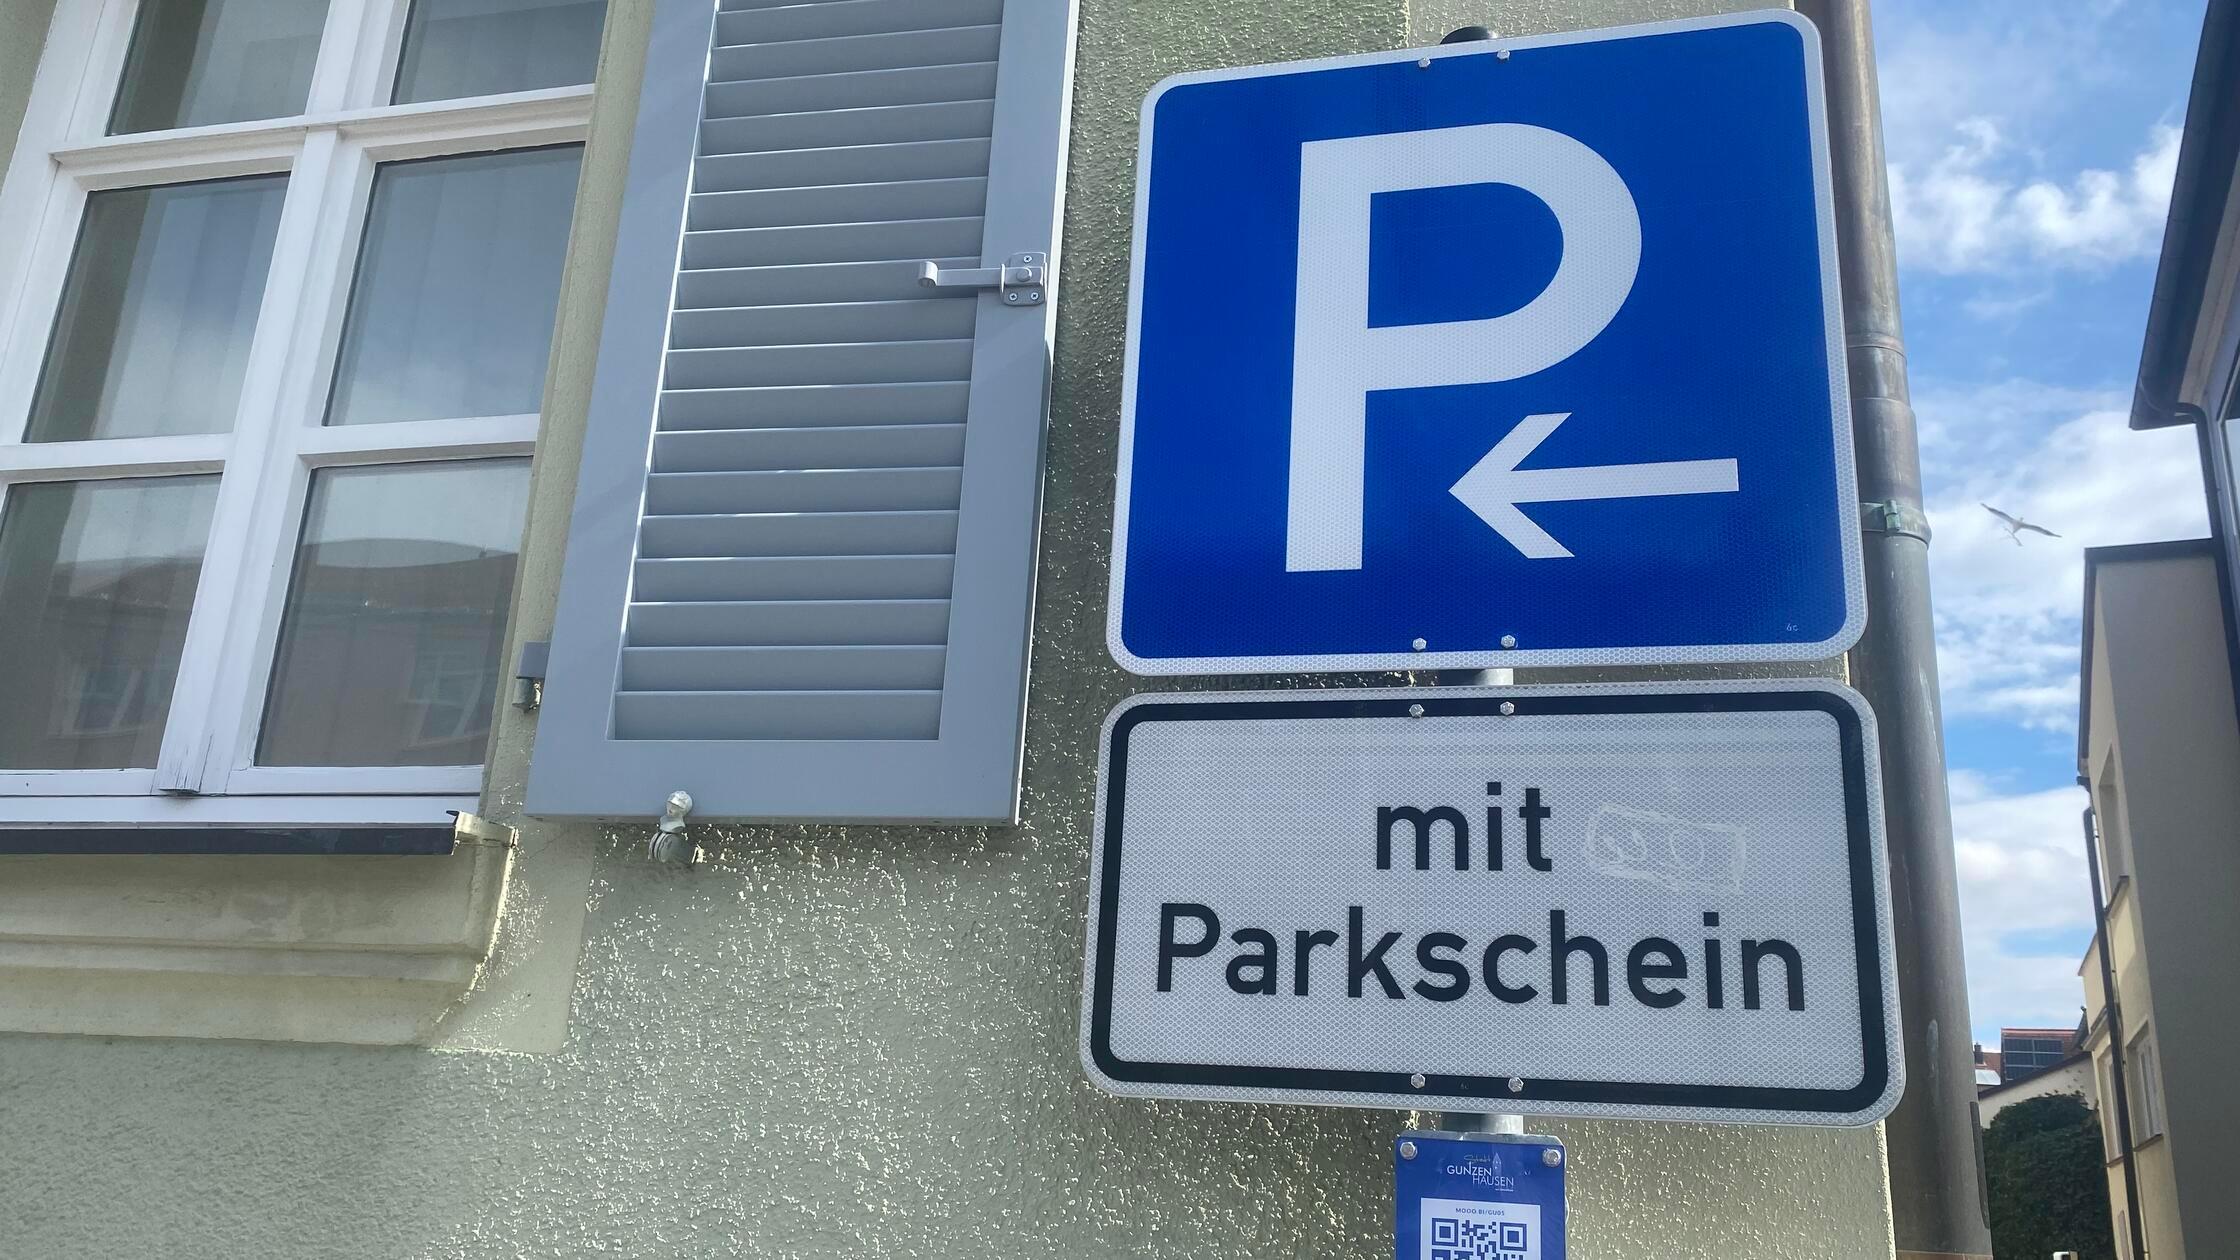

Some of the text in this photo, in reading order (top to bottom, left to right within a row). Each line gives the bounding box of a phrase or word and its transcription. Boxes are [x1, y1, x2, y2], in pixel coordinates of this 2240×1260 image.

[1285, 122, 1642, 573] P
[1375, 780, 1553, 873] mit
[1156, 902, 1806, 1012] Parkschein
[1446, 1161, 1492, 1176] GUNZEN
[1472, 1176, 1514, 1187] HAUSEN
